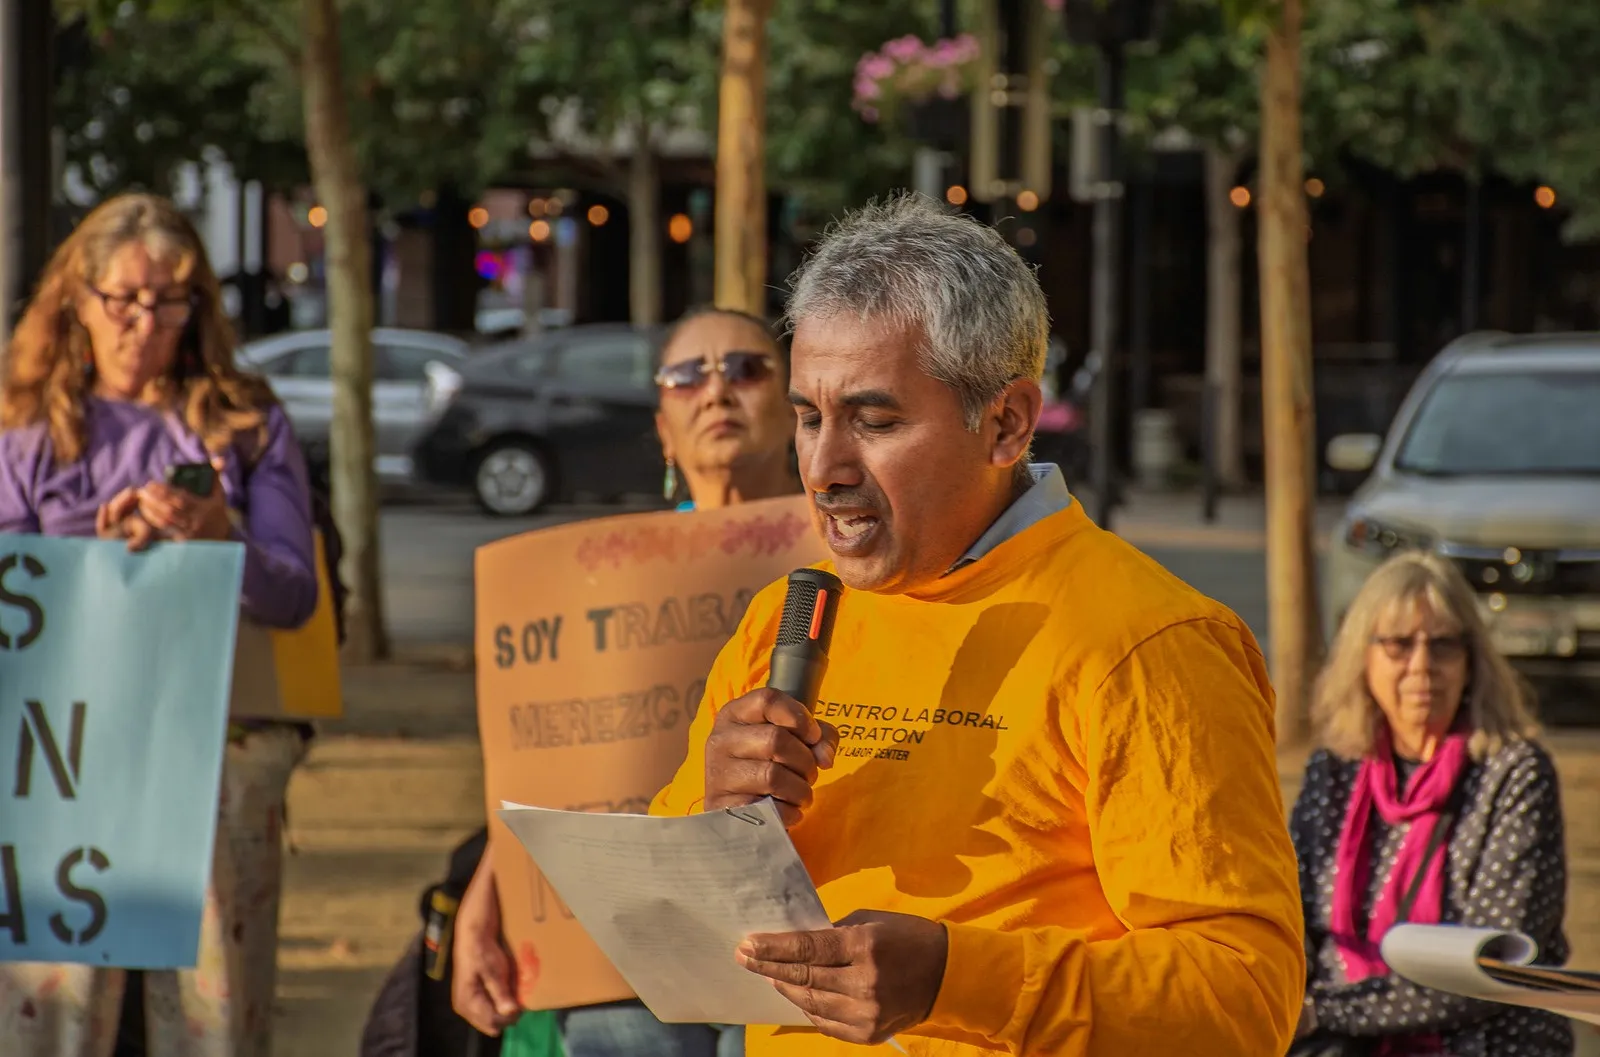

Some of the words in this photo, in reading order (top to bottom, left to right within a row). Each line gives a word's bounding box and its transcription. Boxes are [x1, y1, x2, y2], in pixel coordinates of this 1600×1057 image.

[494, 615, 563, 669] SOY
[815, 699, 897, 722] CENTRO
[902, 707, 1008, 731] LABORAL
[837, 723, 925, 744] GRATON
[845, 747, 873, 758] LABOR
